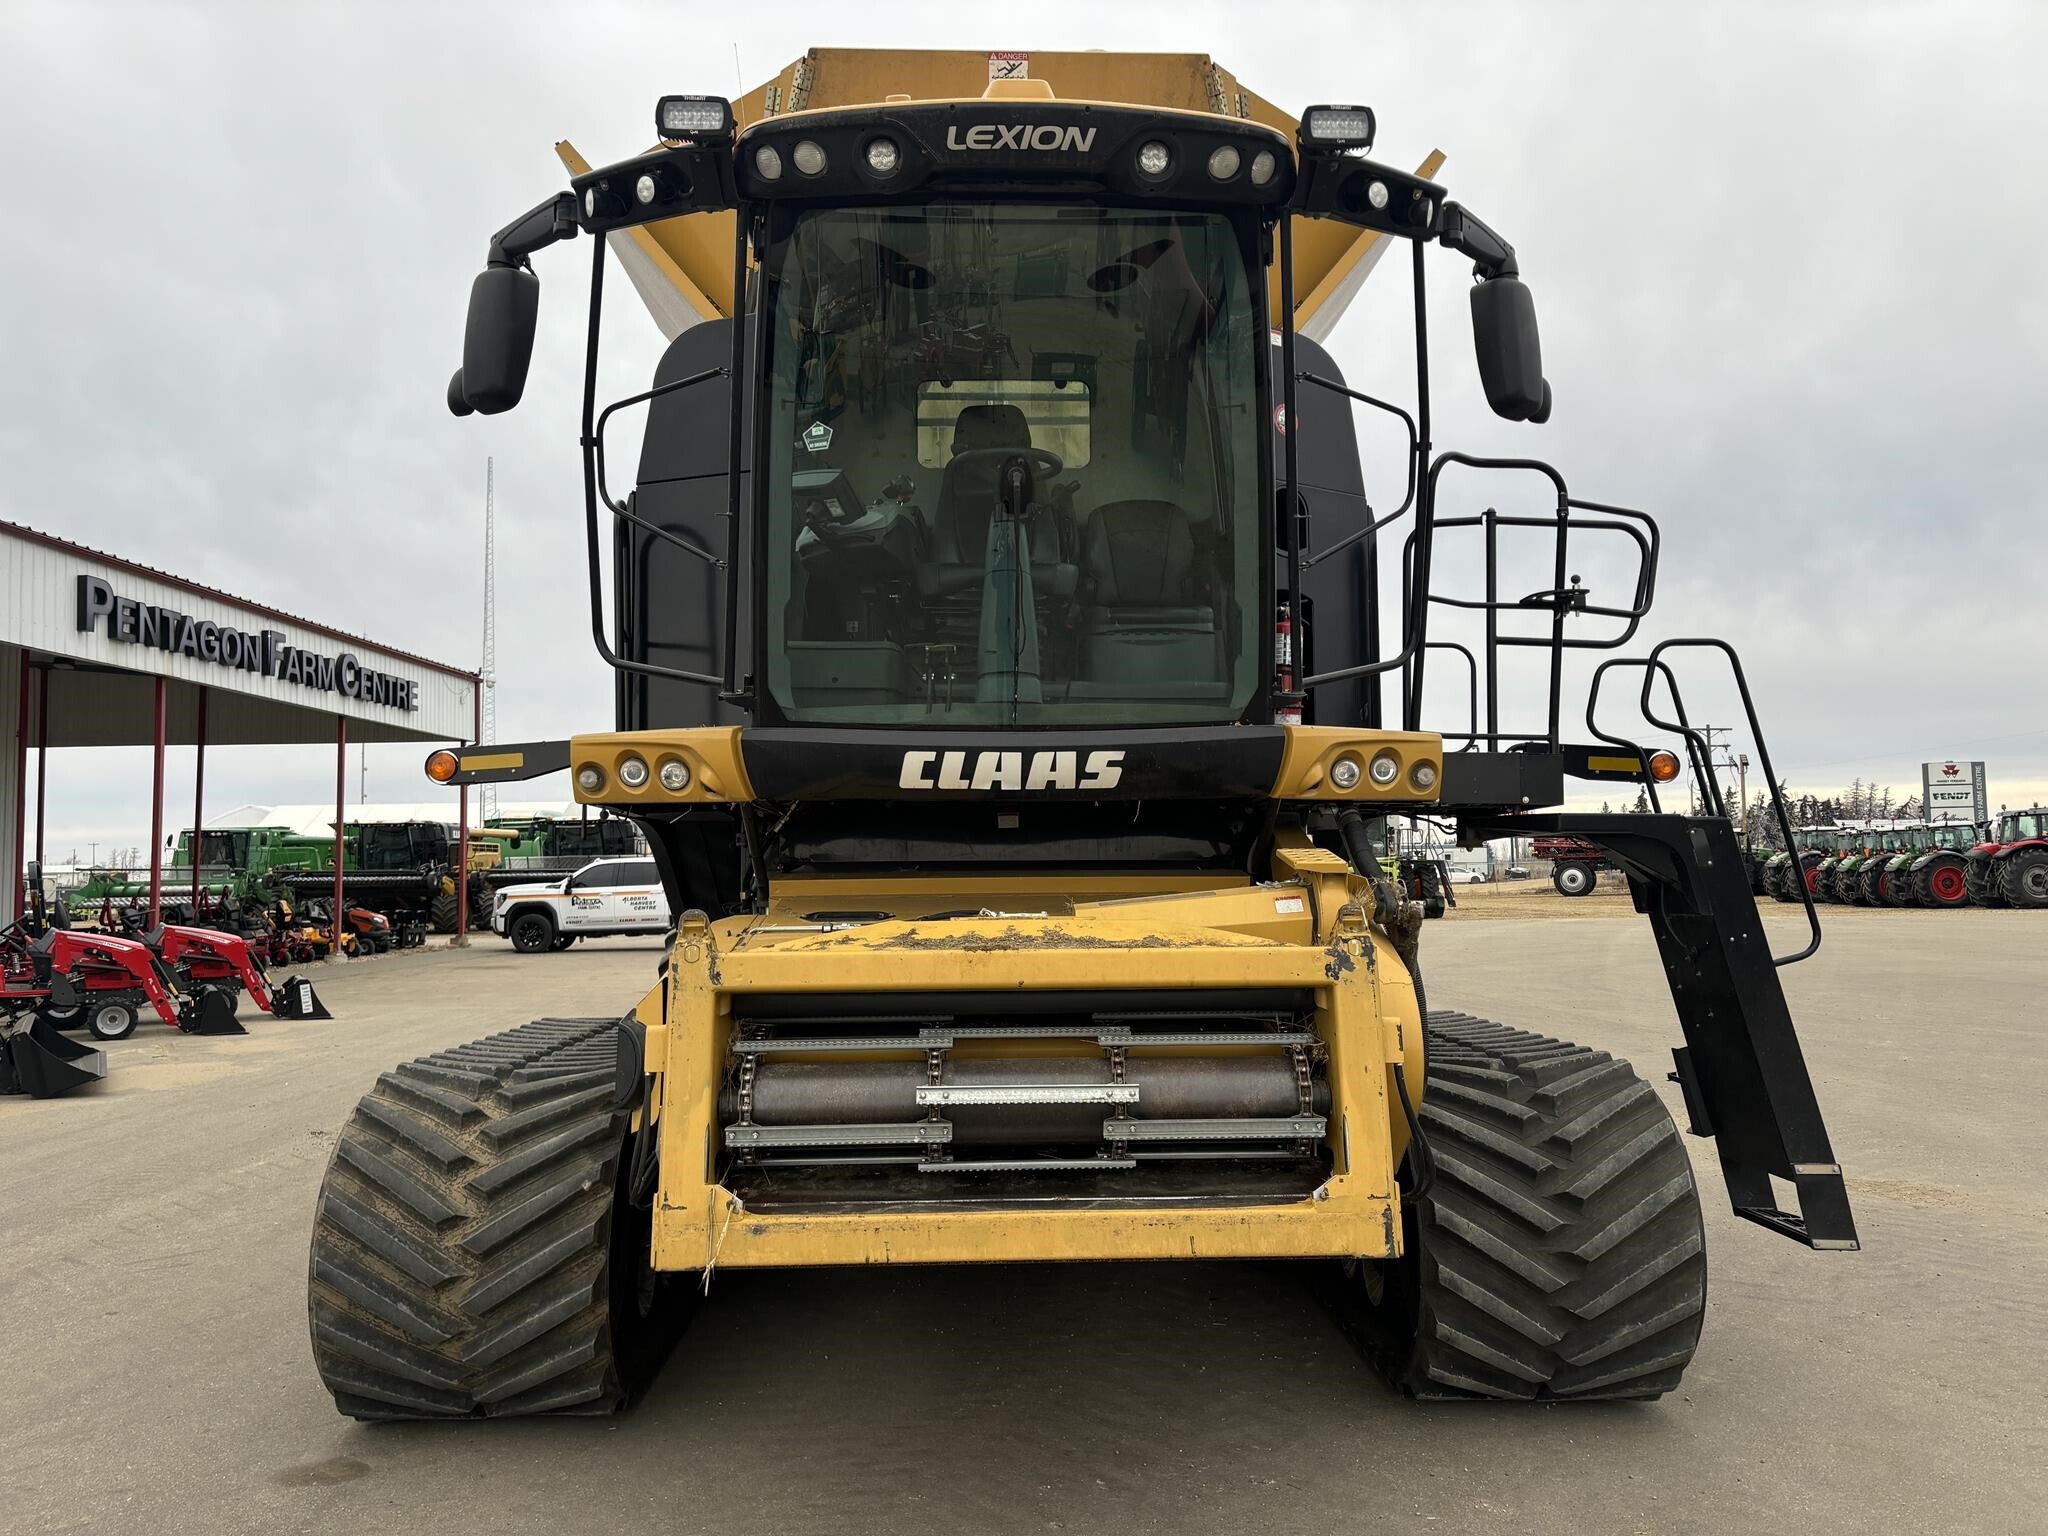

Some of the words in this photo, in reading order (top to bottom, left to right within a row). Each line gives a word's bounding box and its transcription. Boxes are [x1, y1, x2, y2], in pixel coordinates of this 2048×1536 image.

[946, 124, 1097, 152] LEXION
[76, 574, 261, 673] PENTAGON
[261, 629, 336, 692] FARM
[335, 653, 419, 712] CENTRE
[898, 750, 1126, 791] CLAAS
[1932, 792, 1971, 800] FENDT
